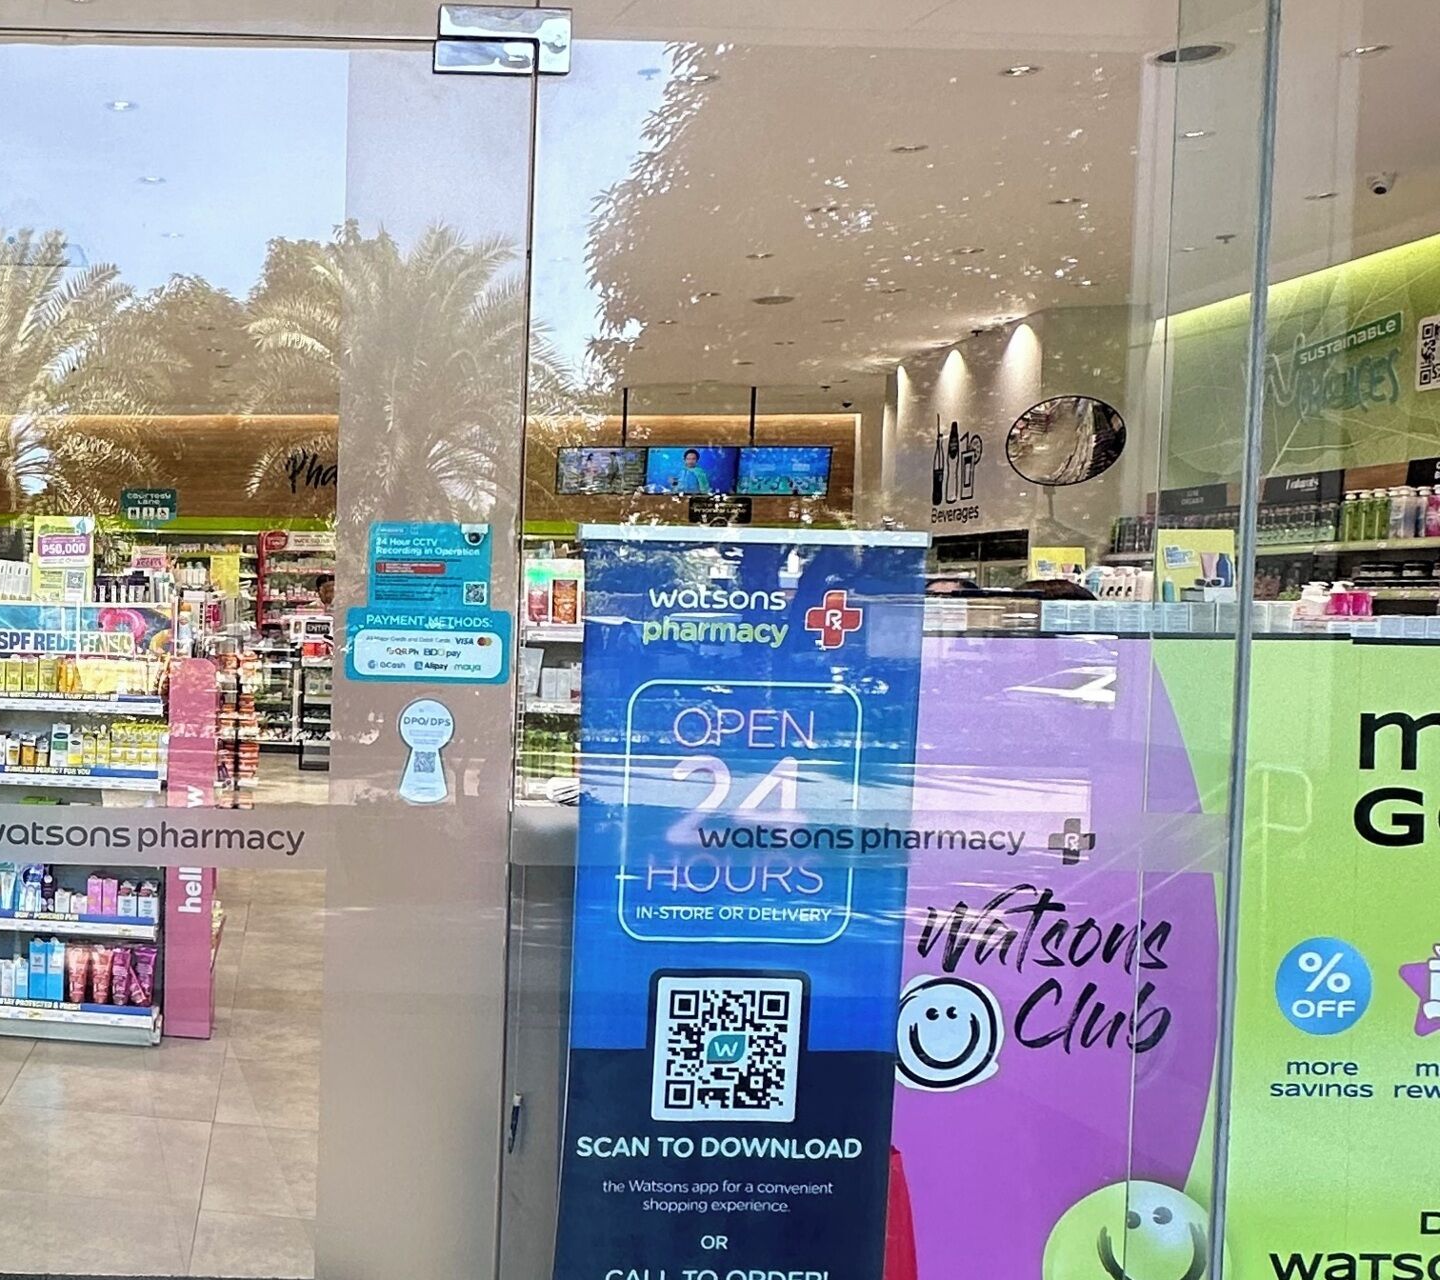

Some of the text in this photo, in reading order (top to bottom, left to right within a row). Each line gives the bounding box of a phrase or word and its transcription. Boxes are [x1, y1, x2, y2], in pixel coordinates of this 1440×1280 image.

[931, 504, 979, 523] Beverages
[376, 547, 480, 557] Recording in Operation
[390, 538, 411, 546] Hour
[413, 538, 438, 547] CCTV
[647, 586, 788, 611] watsons
[366, 614, 425, 626] PAYMENT
[641, 616, 789, 649] pharmacy
[403, 716, 452, 728] DPO/DPS
[673, 708, 816, 751] OPEN
[666, 755, 810, 846] 24
[137, 821, 305, 856] pharmacy
[698, 824, 854, 851] watsons
[860, 821, 1026, 855] pharmacy
[645, 854, 825, 895] HOURS
[635, 905, 832, 923] IN-STORE OR DELIVERY
[916, 882, 1173, 973] Watsons
[1013, 978, 1173, 1054] Club
[1291, 999, 1356, 1018] OFF
[1287, 1060, 1359, 1076] more
[575, 1136, 862, 1159] SCAN TO DOWNLOAD
[603, 1180, 834, 1196] the Watsons app for a convenient
[642, 1198, 791, 1213] shopping experience.
[700, 1235, 728, 1250] OR
